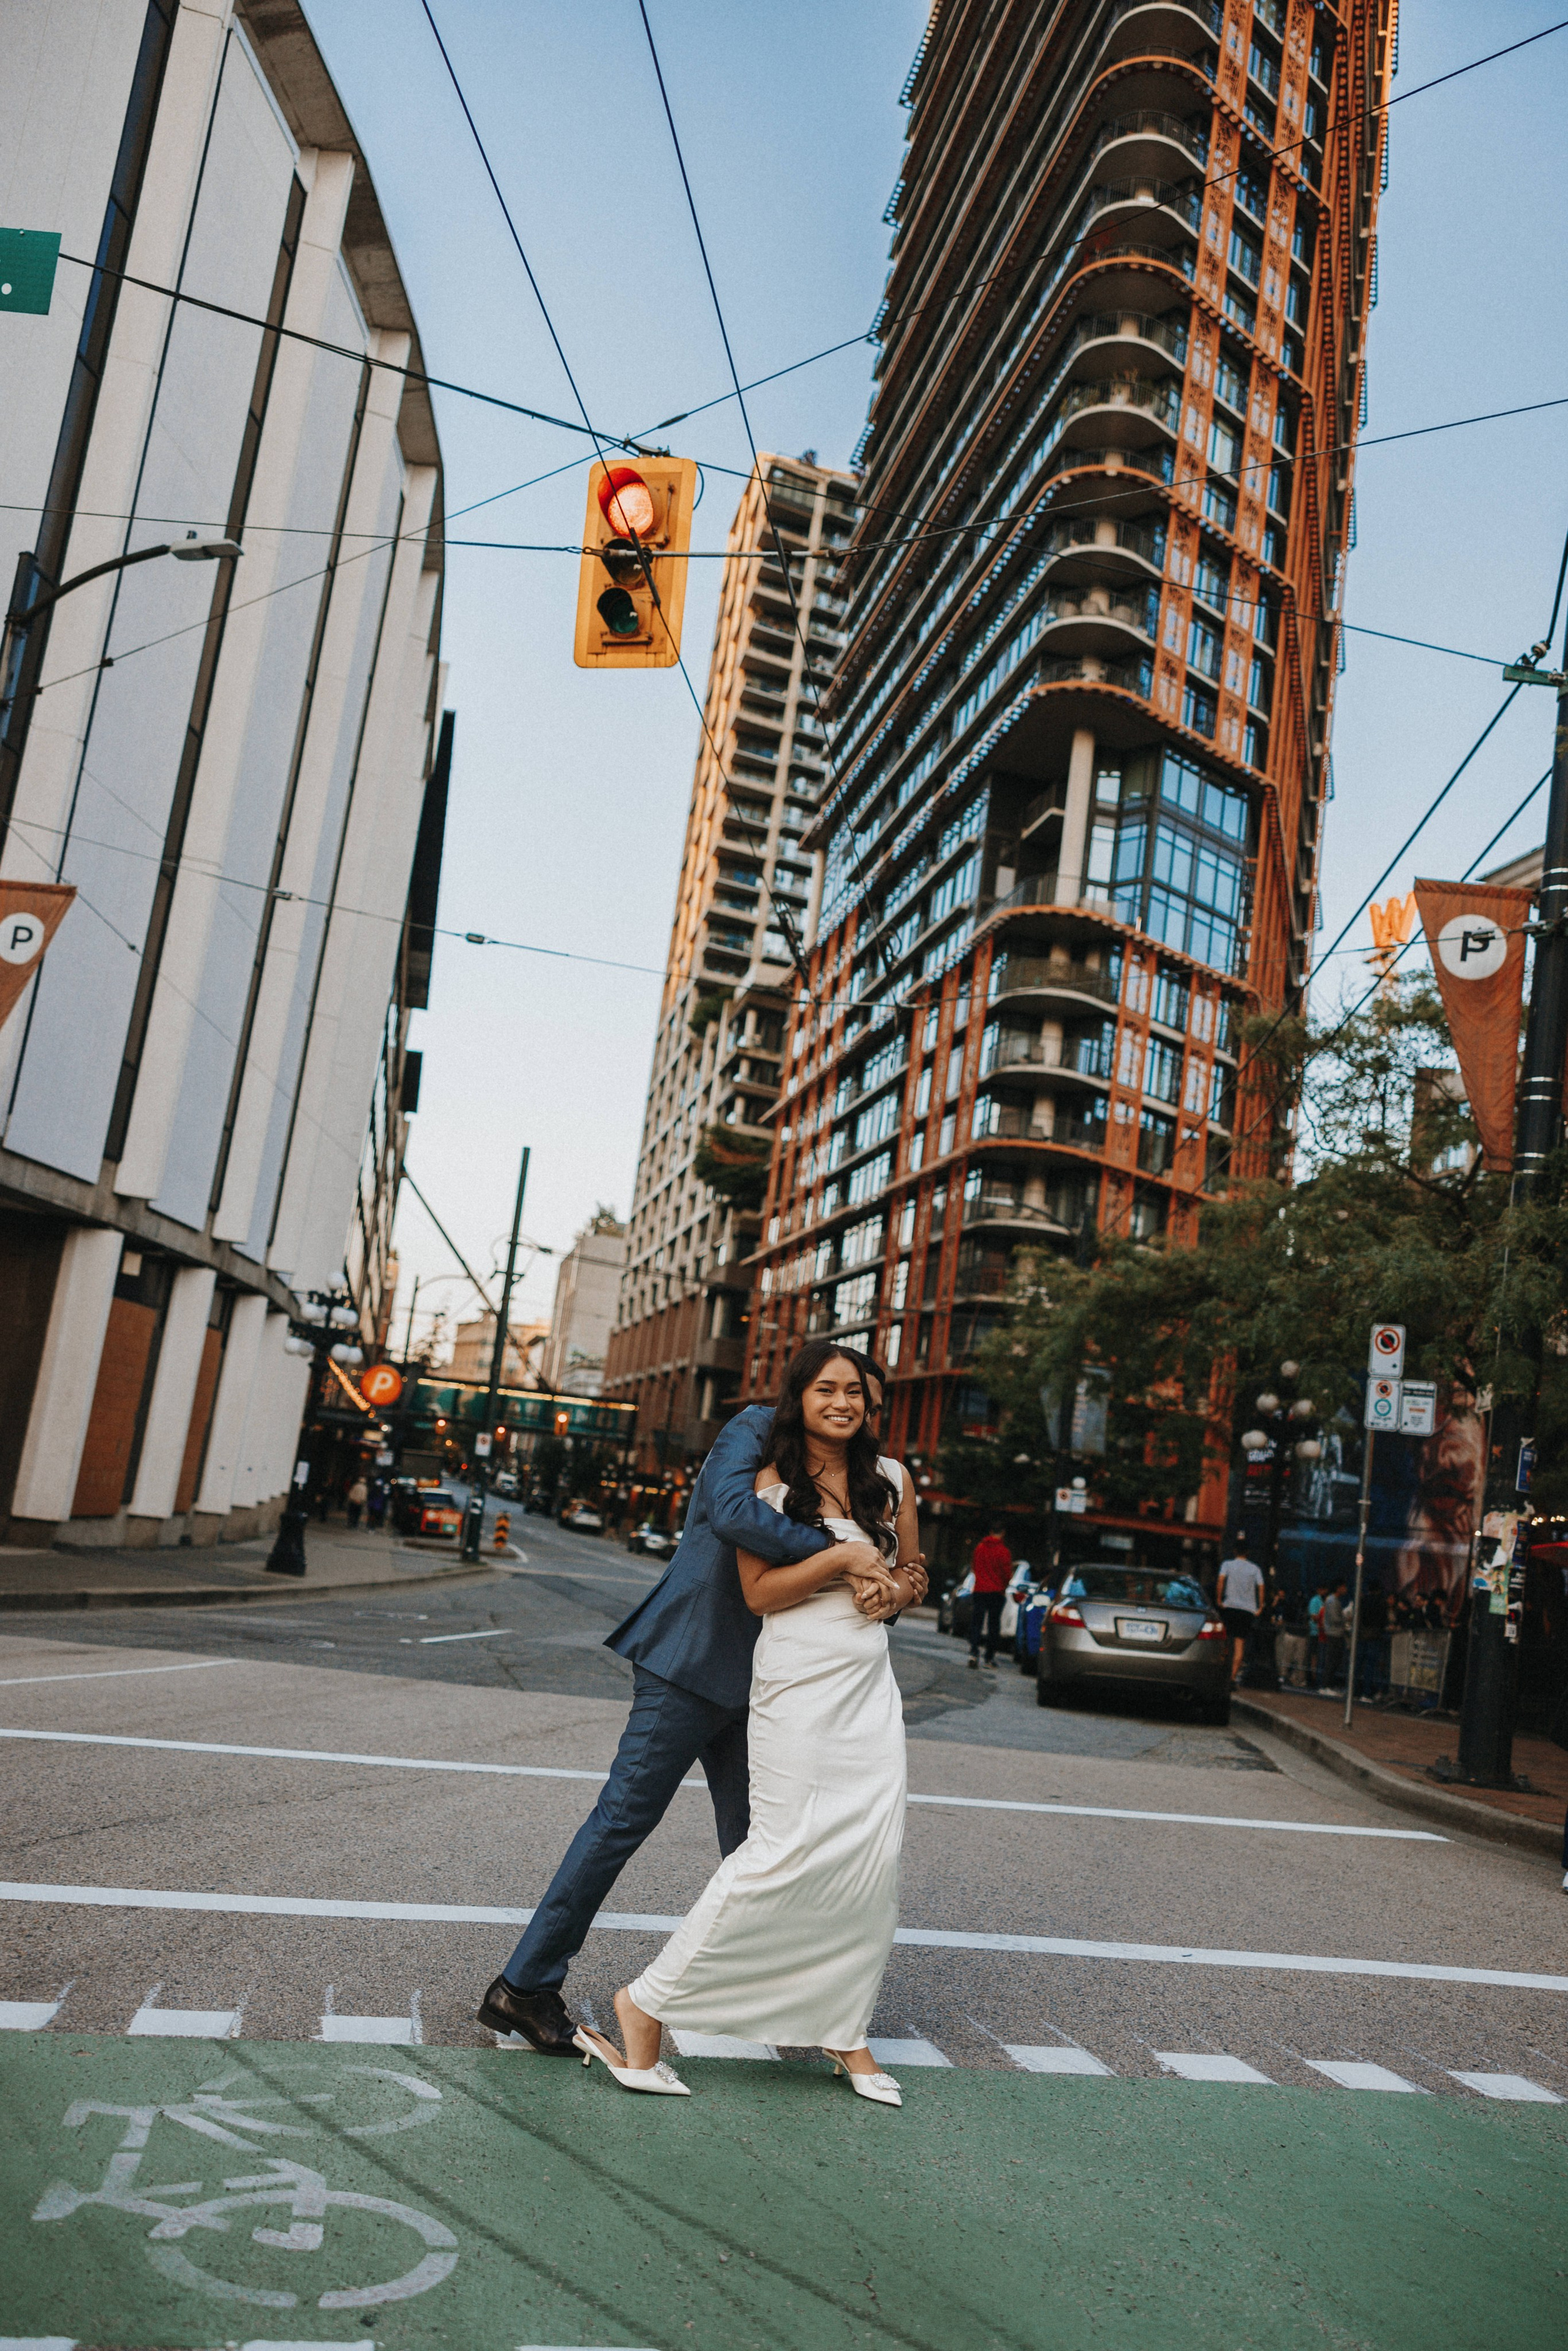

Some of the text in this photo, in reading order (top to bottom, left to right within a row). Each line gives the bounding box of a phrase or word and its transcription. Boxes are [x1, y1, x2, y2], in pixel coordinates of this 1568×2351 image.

[1369, 891, 1419, 947] W
[10, 926, 33, 949] P
[1460, 931, 1490, 961] P
[370, 1372, 393, 1397] P
